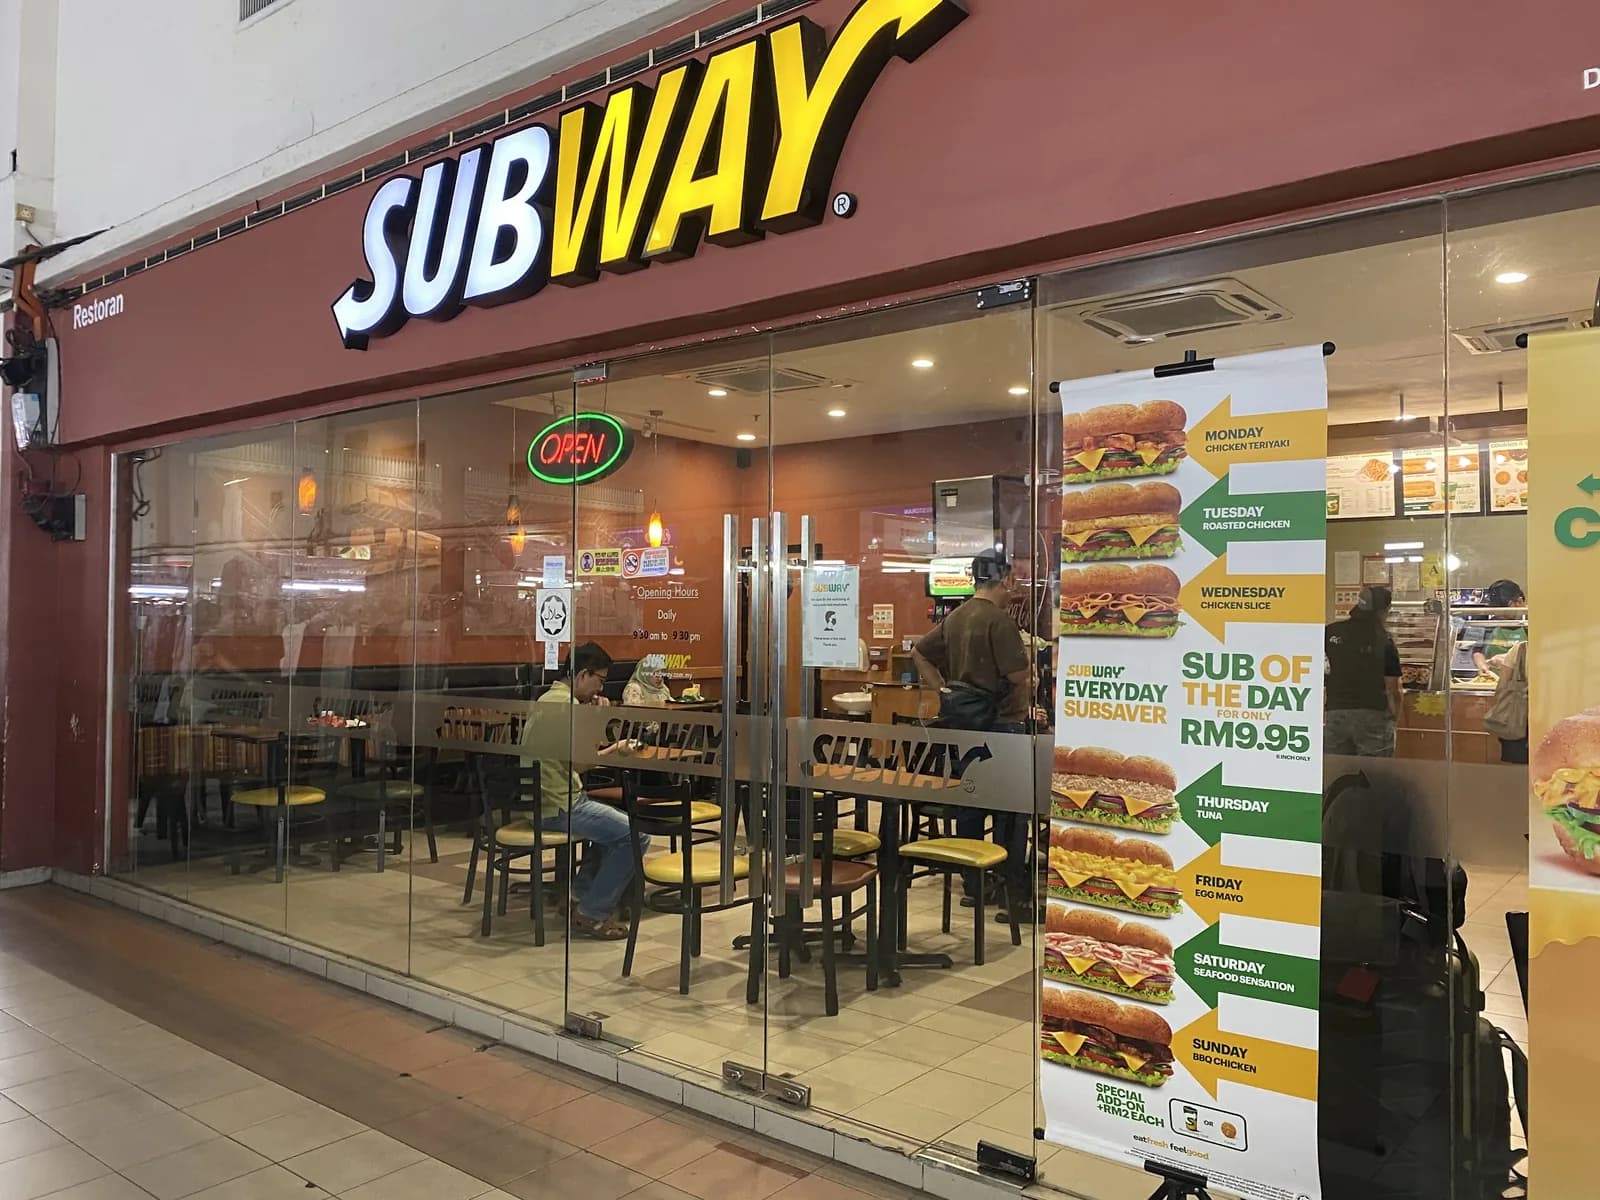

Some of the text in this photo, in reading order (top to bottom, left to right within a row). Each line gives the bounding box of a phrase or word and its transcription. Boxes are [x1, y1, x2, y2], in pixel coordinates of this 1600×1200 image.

[331, 0, 958, 348] SUBWAY
[73, 294, 124, 330] Restoran
[1205, 427, 1264, 441] MONDAY
[541, 433, 605, 464] OPEN
[1205, 440, 1290, 452] CHICKEN TERIYAKI
[1203, 506, 1264, 519] TUESDAY
[1203, 520, 1290, 530] ROASTED CHICKEN
[637, 586, 699, 600] Opening Hours
[1201, 587, 1285, 598] WEDNESDAY
[1201, 601, 1271, 610] CHICKEN SLICE
[657, 609, 677, 622] Daily
[661, 632, 668, 640] to
[642, 653, 692, 669] SUBWAY
[1182, 652, 1313, 684] SUB OF
[1066, 664, 1126, 678] SUBWAY
[1065, 679, 1168, 703] EVERYDAY
[1182, 682, 1312, 711] THE DAY
[1064, 700, 1168, 724] SUBSAVER
[1217, 710, 1272, 721] FOR ONLY
[1181, 718, 1310, 753] RM9.95
[801, 733, 992, 790] SUBWAY
[1196, 795, 1270, 813] THURSDAY
[1196, 809, 1223, 820] TUNA
[1196, 874, 1243, 890] FRIDAY
[1195, 889, 1244, 902] EGG MAYO
[1193, 953, 1265, 974] SATURDAY
[1193, 967, 1295, 993] SEAFOOD SENSATION
[1193, 1038, 1248, 1059] SUNDAY
[1193, 1053, 1257, 1074] BBQ CHICKEN
[1096, 1082, 1145, 1104] SPECIAL
[1096, 1093, 1145, 1113] ADD-ON
[1096, 1103, 1165, 1128] +RM2 EACH
